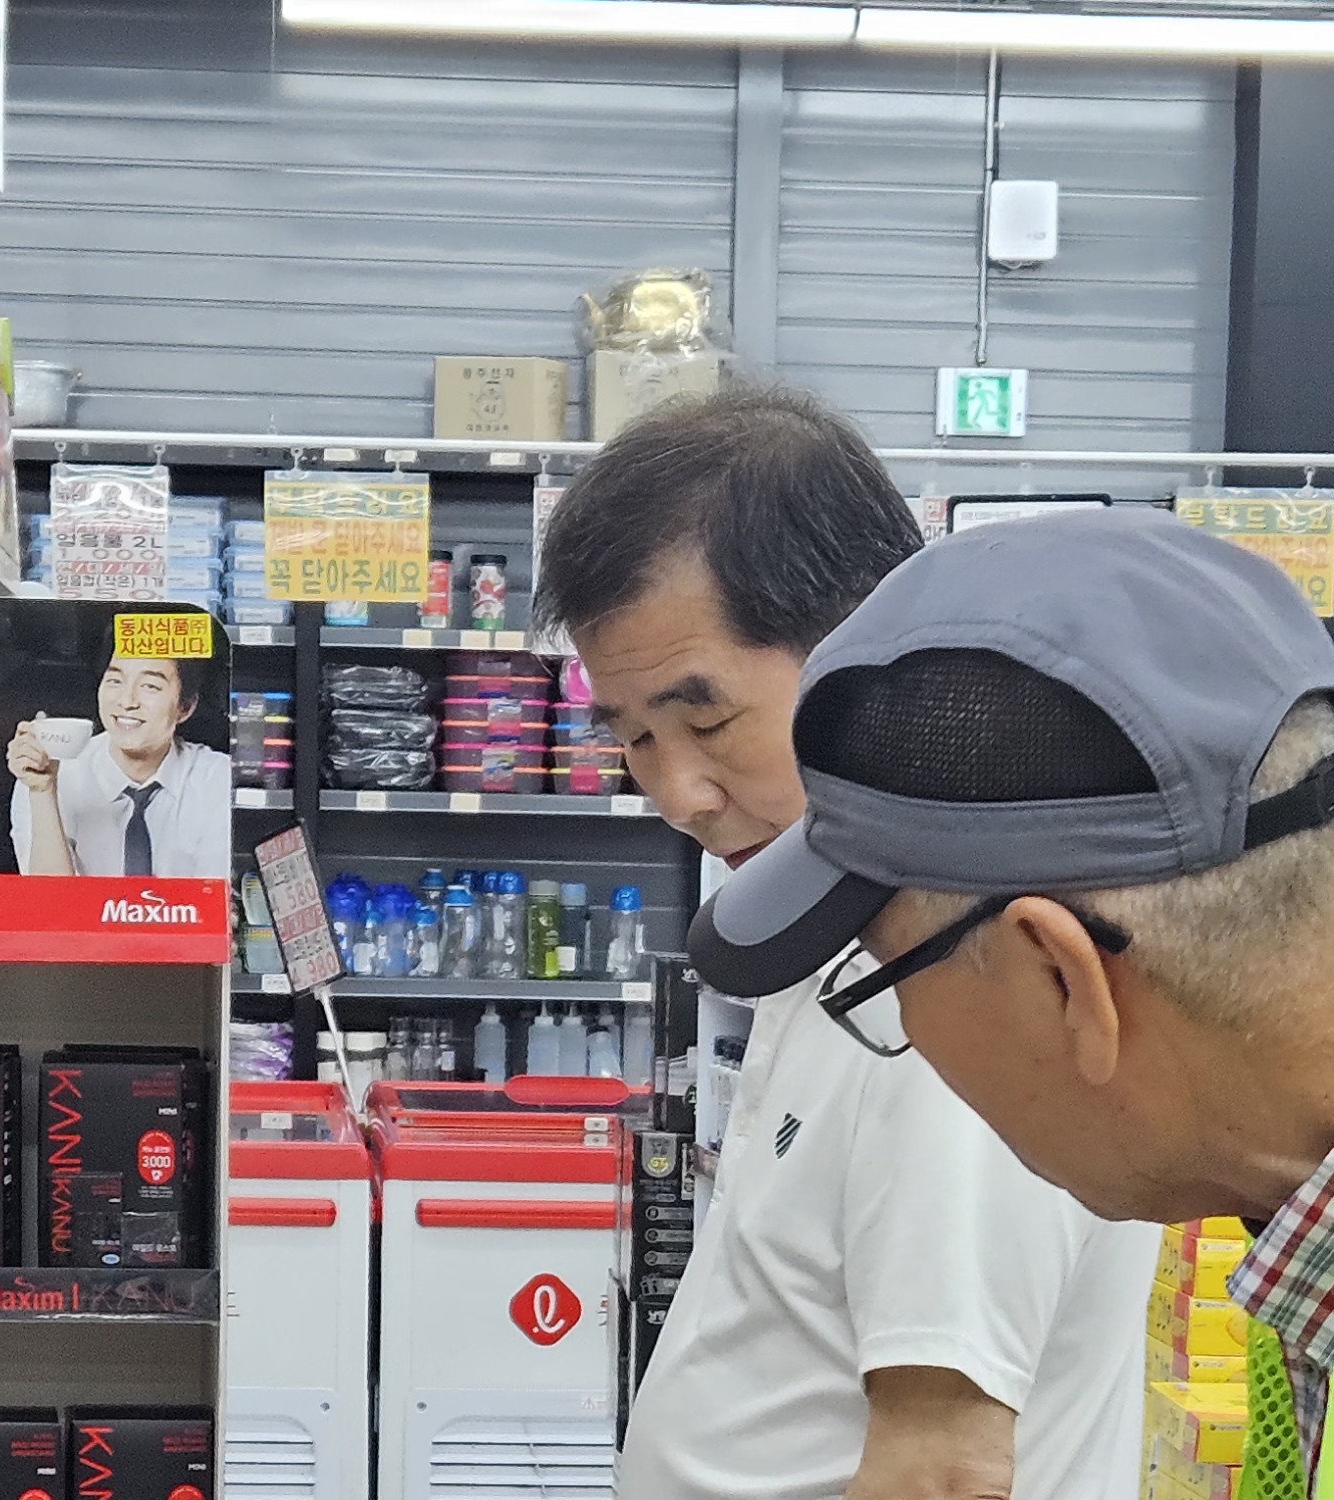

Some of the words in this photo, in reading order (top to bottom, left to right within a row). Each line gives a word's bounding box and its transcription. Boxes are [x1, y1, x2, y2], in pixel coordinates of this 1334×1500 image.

[132, 536, 163, 549] 2L
[301, 559, 423, 595] 닫아주세요
[101, 890, 200, 925] Maxim
[51, 1178, 73, 1253] KANU
